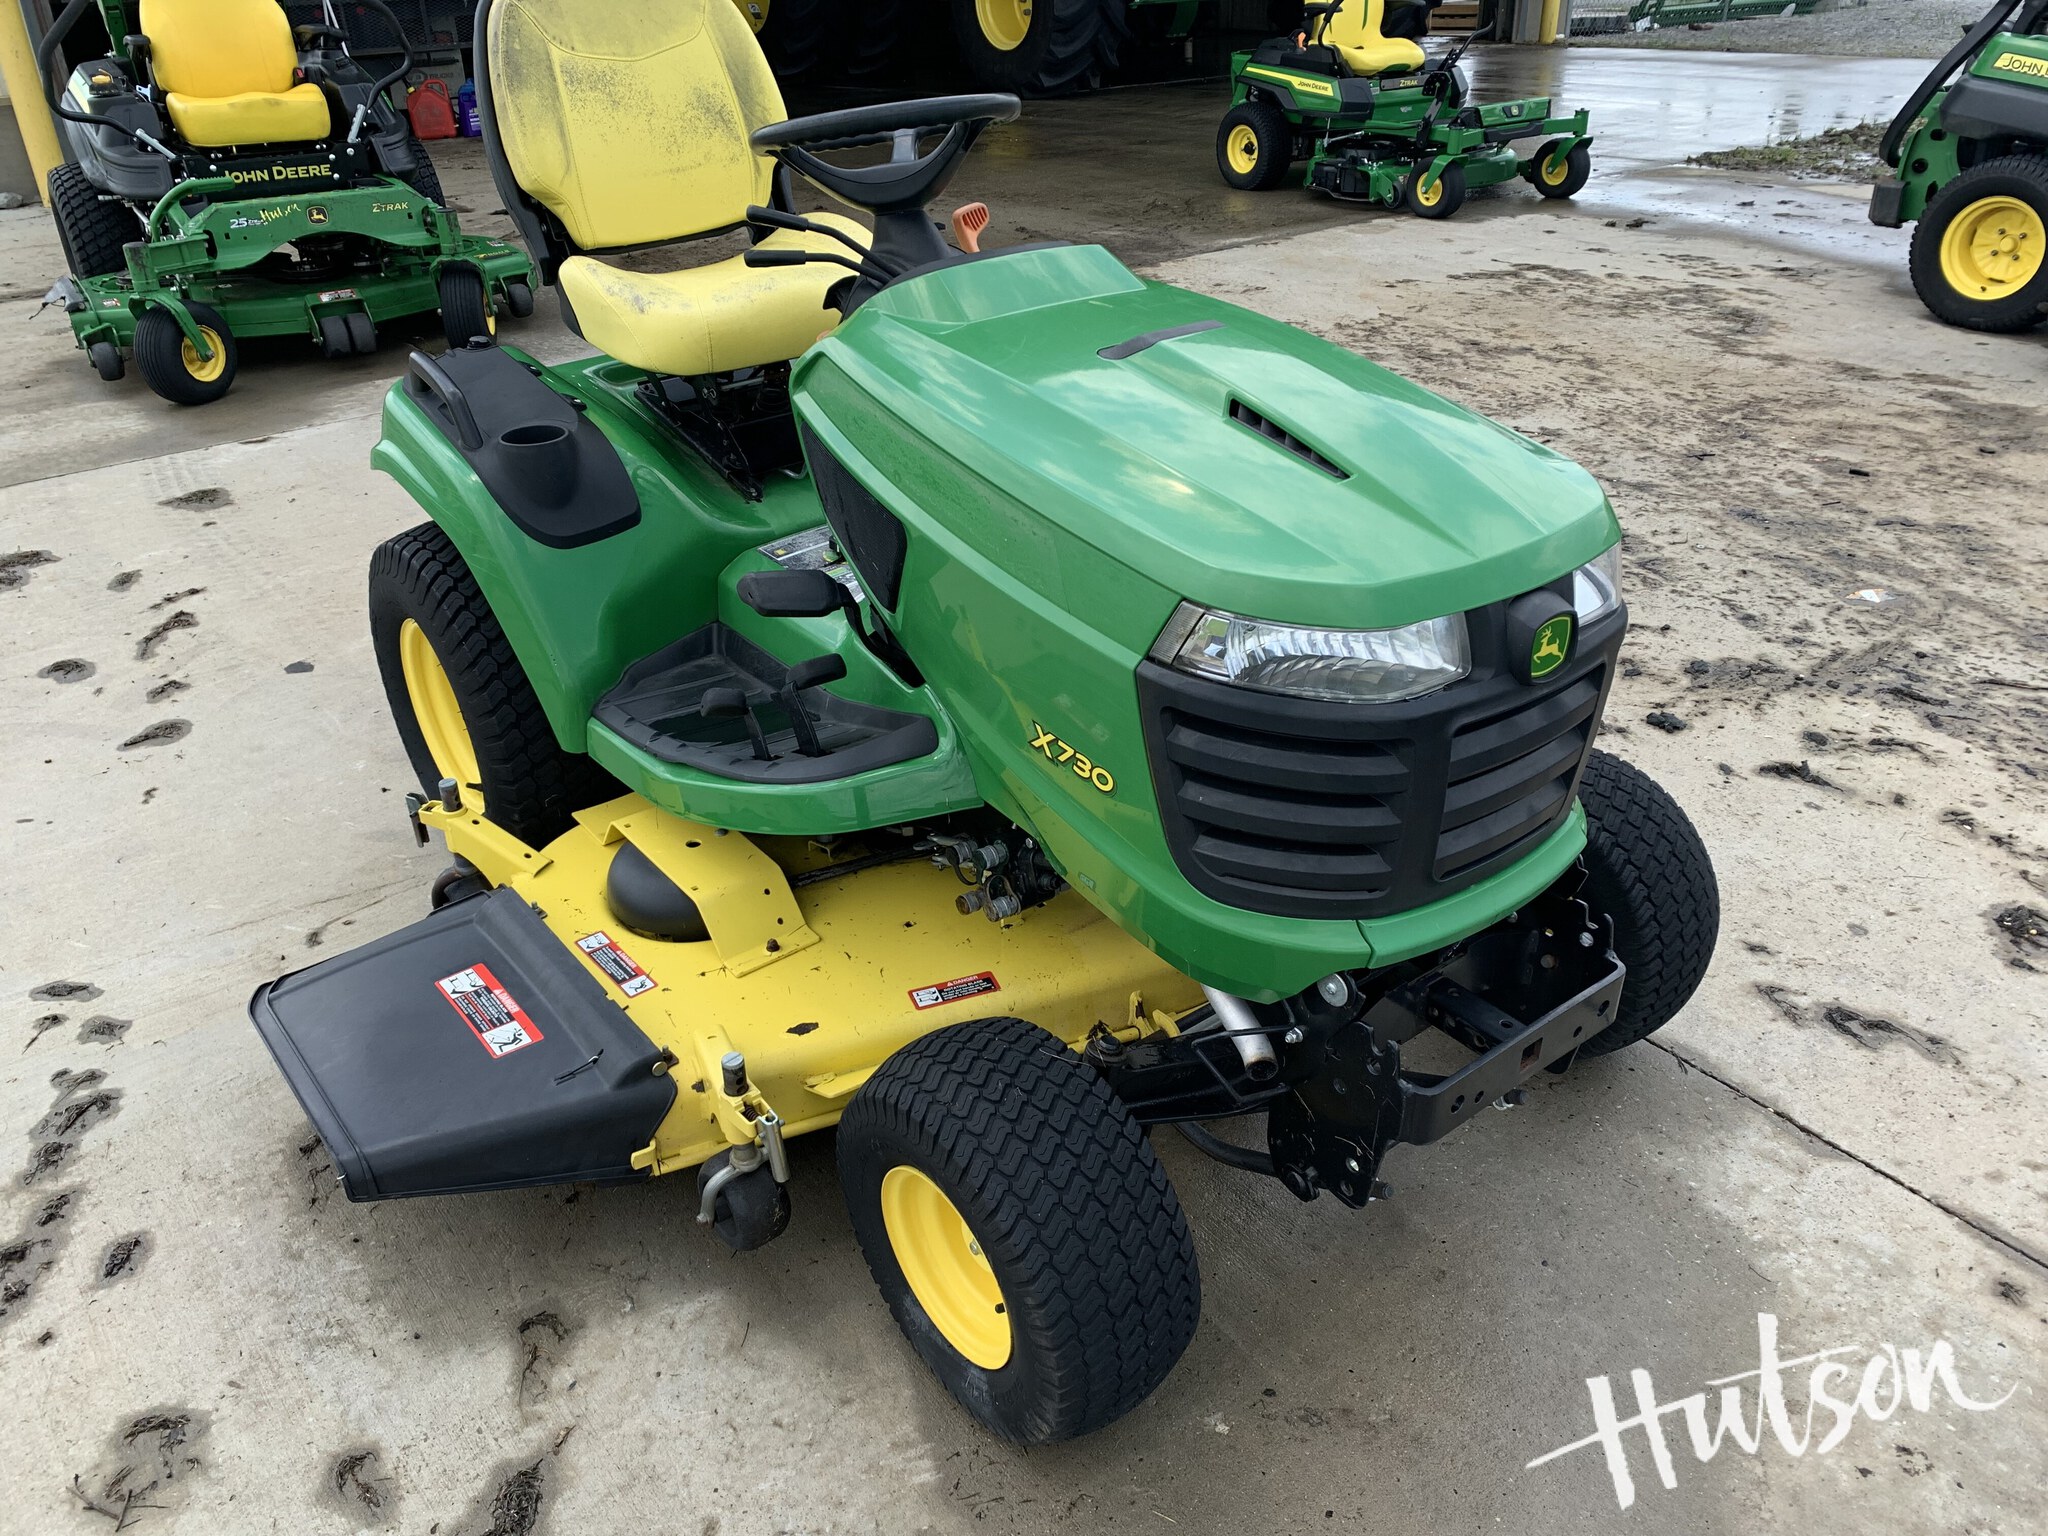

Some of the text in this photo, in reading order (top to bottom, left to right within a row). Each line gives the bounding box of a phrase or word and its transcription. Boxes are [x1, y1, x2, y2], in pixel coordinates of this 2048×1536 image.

[2002, 56, 2043, 74] JOHN
[1312, 82, 1329, 92] DEERE
[272, 163, 332, 180] DEERE
[372, 201, 409, 213] ZTRAK
[229, 217, 248, 229] 25
[1029, 721, 1115, 793] X730
[953, 975, 979, 985] DANGER
[497, 992, 520, 1014] DANGER
